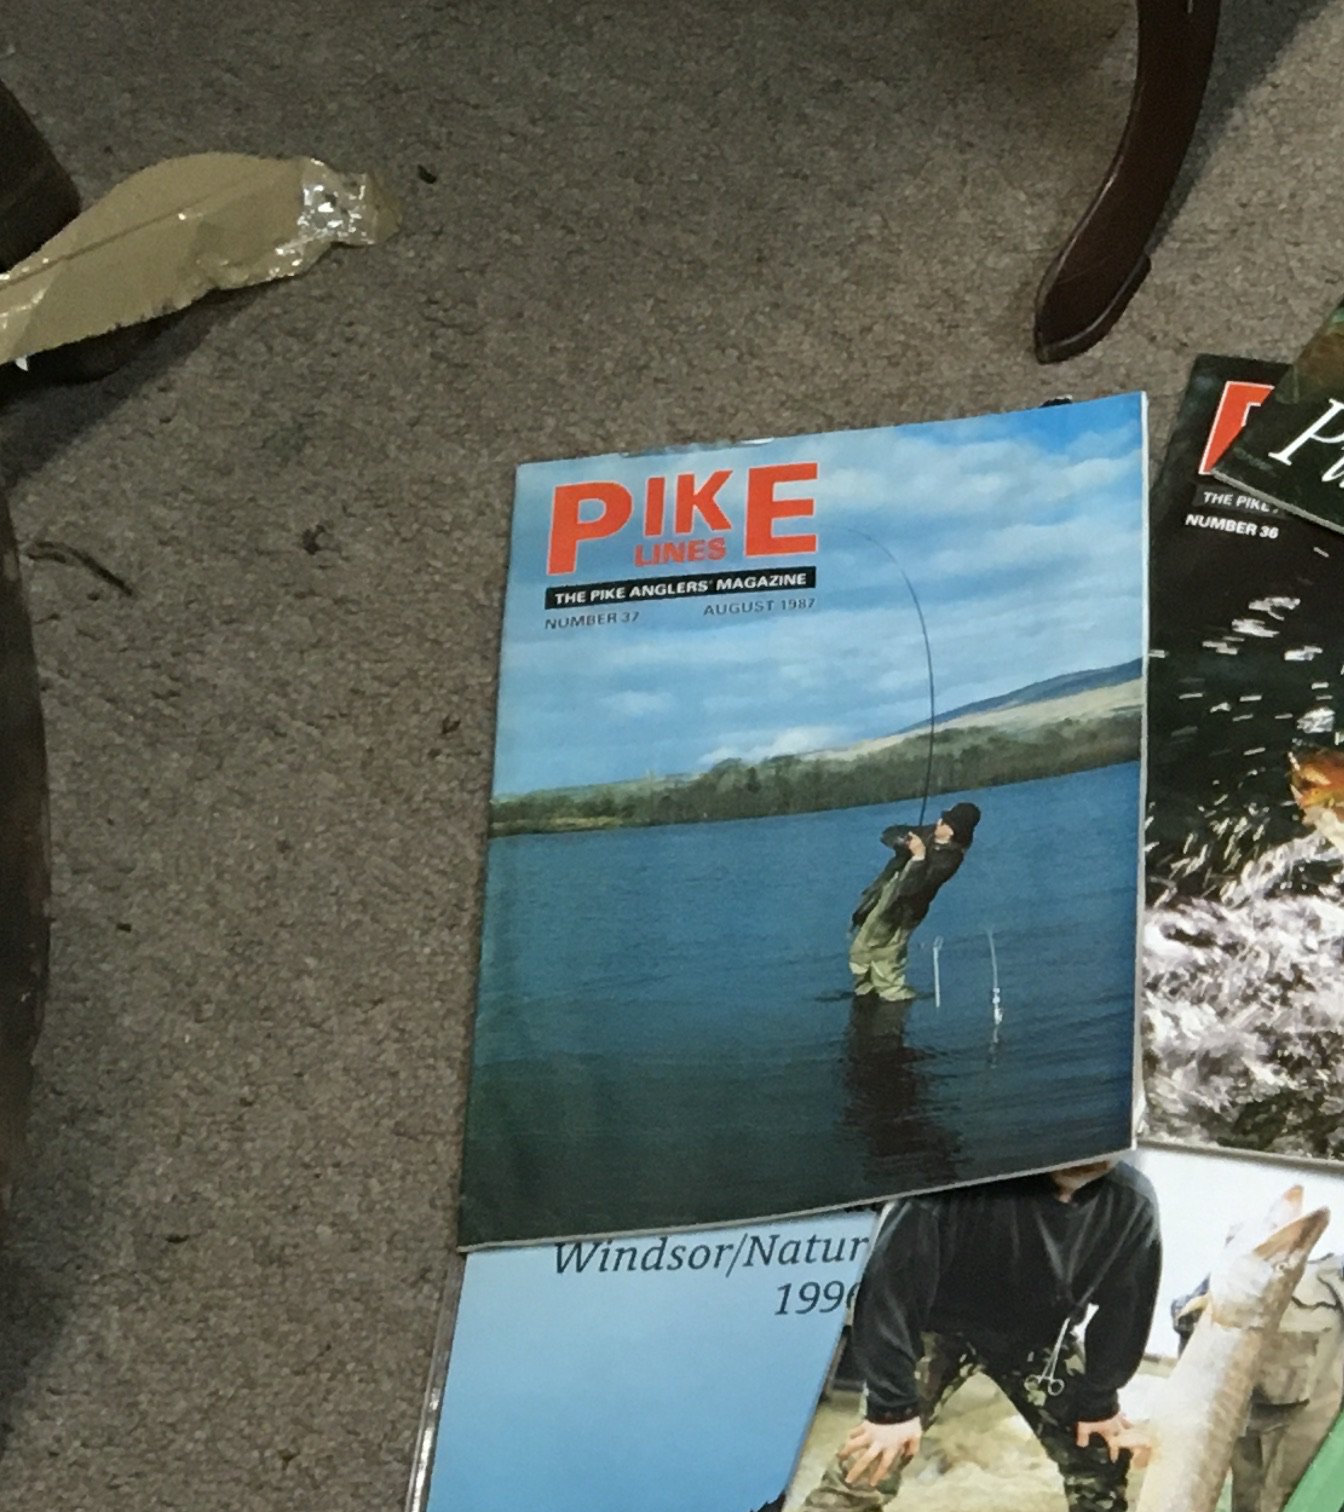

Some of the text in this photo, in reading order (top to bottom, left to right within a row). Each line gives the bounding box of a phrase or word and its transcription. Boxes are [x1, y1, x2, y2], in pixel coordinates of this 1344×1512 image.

[1203, 491, 1233, 507] THE
[546, 462, 818, 576] PIKE
[1185, 513, 1279, 539] NUMBER 36
[633, 537, 728, 567] LINES
[554, 591, 586, 606] THE
[590, 587, 626, 602] PIKE
[715, 572, 807, 591] MAGAZINE
[545, 597, 816, 630] NUMBER 37 AUGUST 1987
